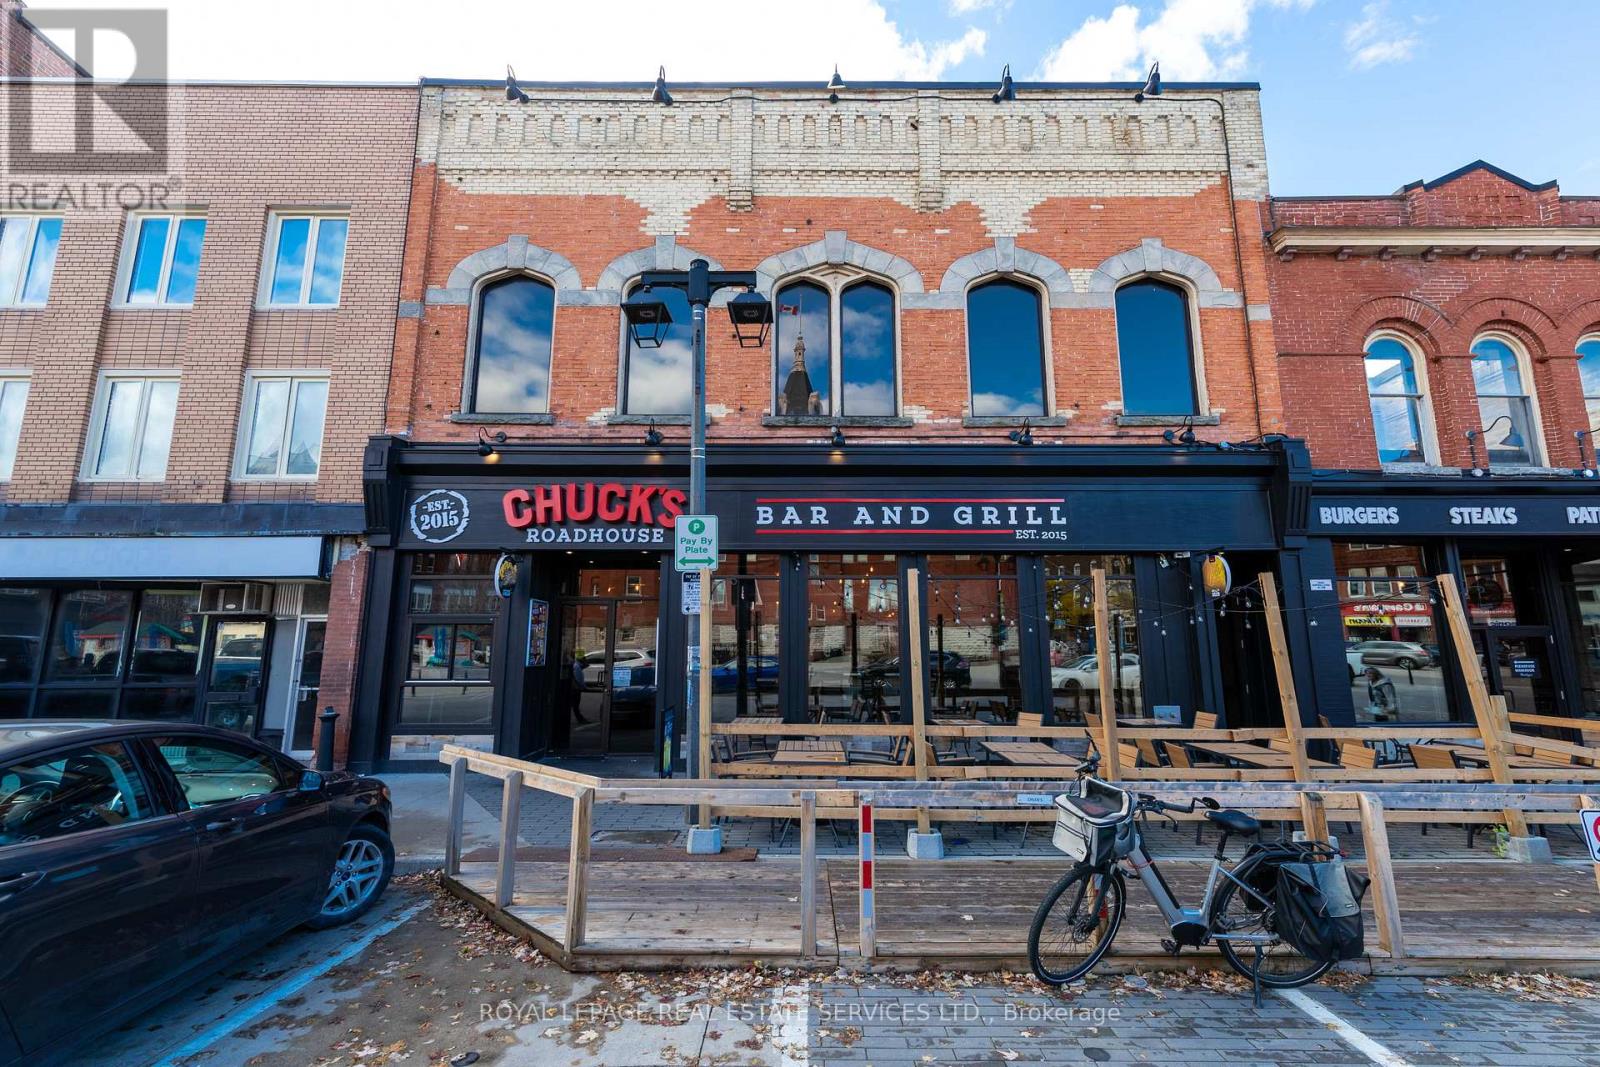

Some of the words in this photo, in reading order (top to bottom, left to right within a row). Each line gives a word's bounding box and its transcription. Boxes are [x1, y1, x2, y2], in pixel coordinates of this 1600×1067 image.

[502, 482, 687, 528] CHUCK'S
[420, 510, 459, 530] 2015
[756, 506, 829, 525] BAR
[853, 506, 930, 525] AND
[953, 506, 1067, 525] GRILL
[1319, 507, 1399, 524] BURGERS
[1449, 507, 1518, 525] STEAKS
[1566, 506, 1600, 523] PAT
[526, 528, 664, 543] ROADHOUSE
[680, 537, 697, 545] Pay
[701, 537, 712, 545] By
[1015, 529, 1039, 539] EST.
[1041, 531, 1067, 540] 2015
